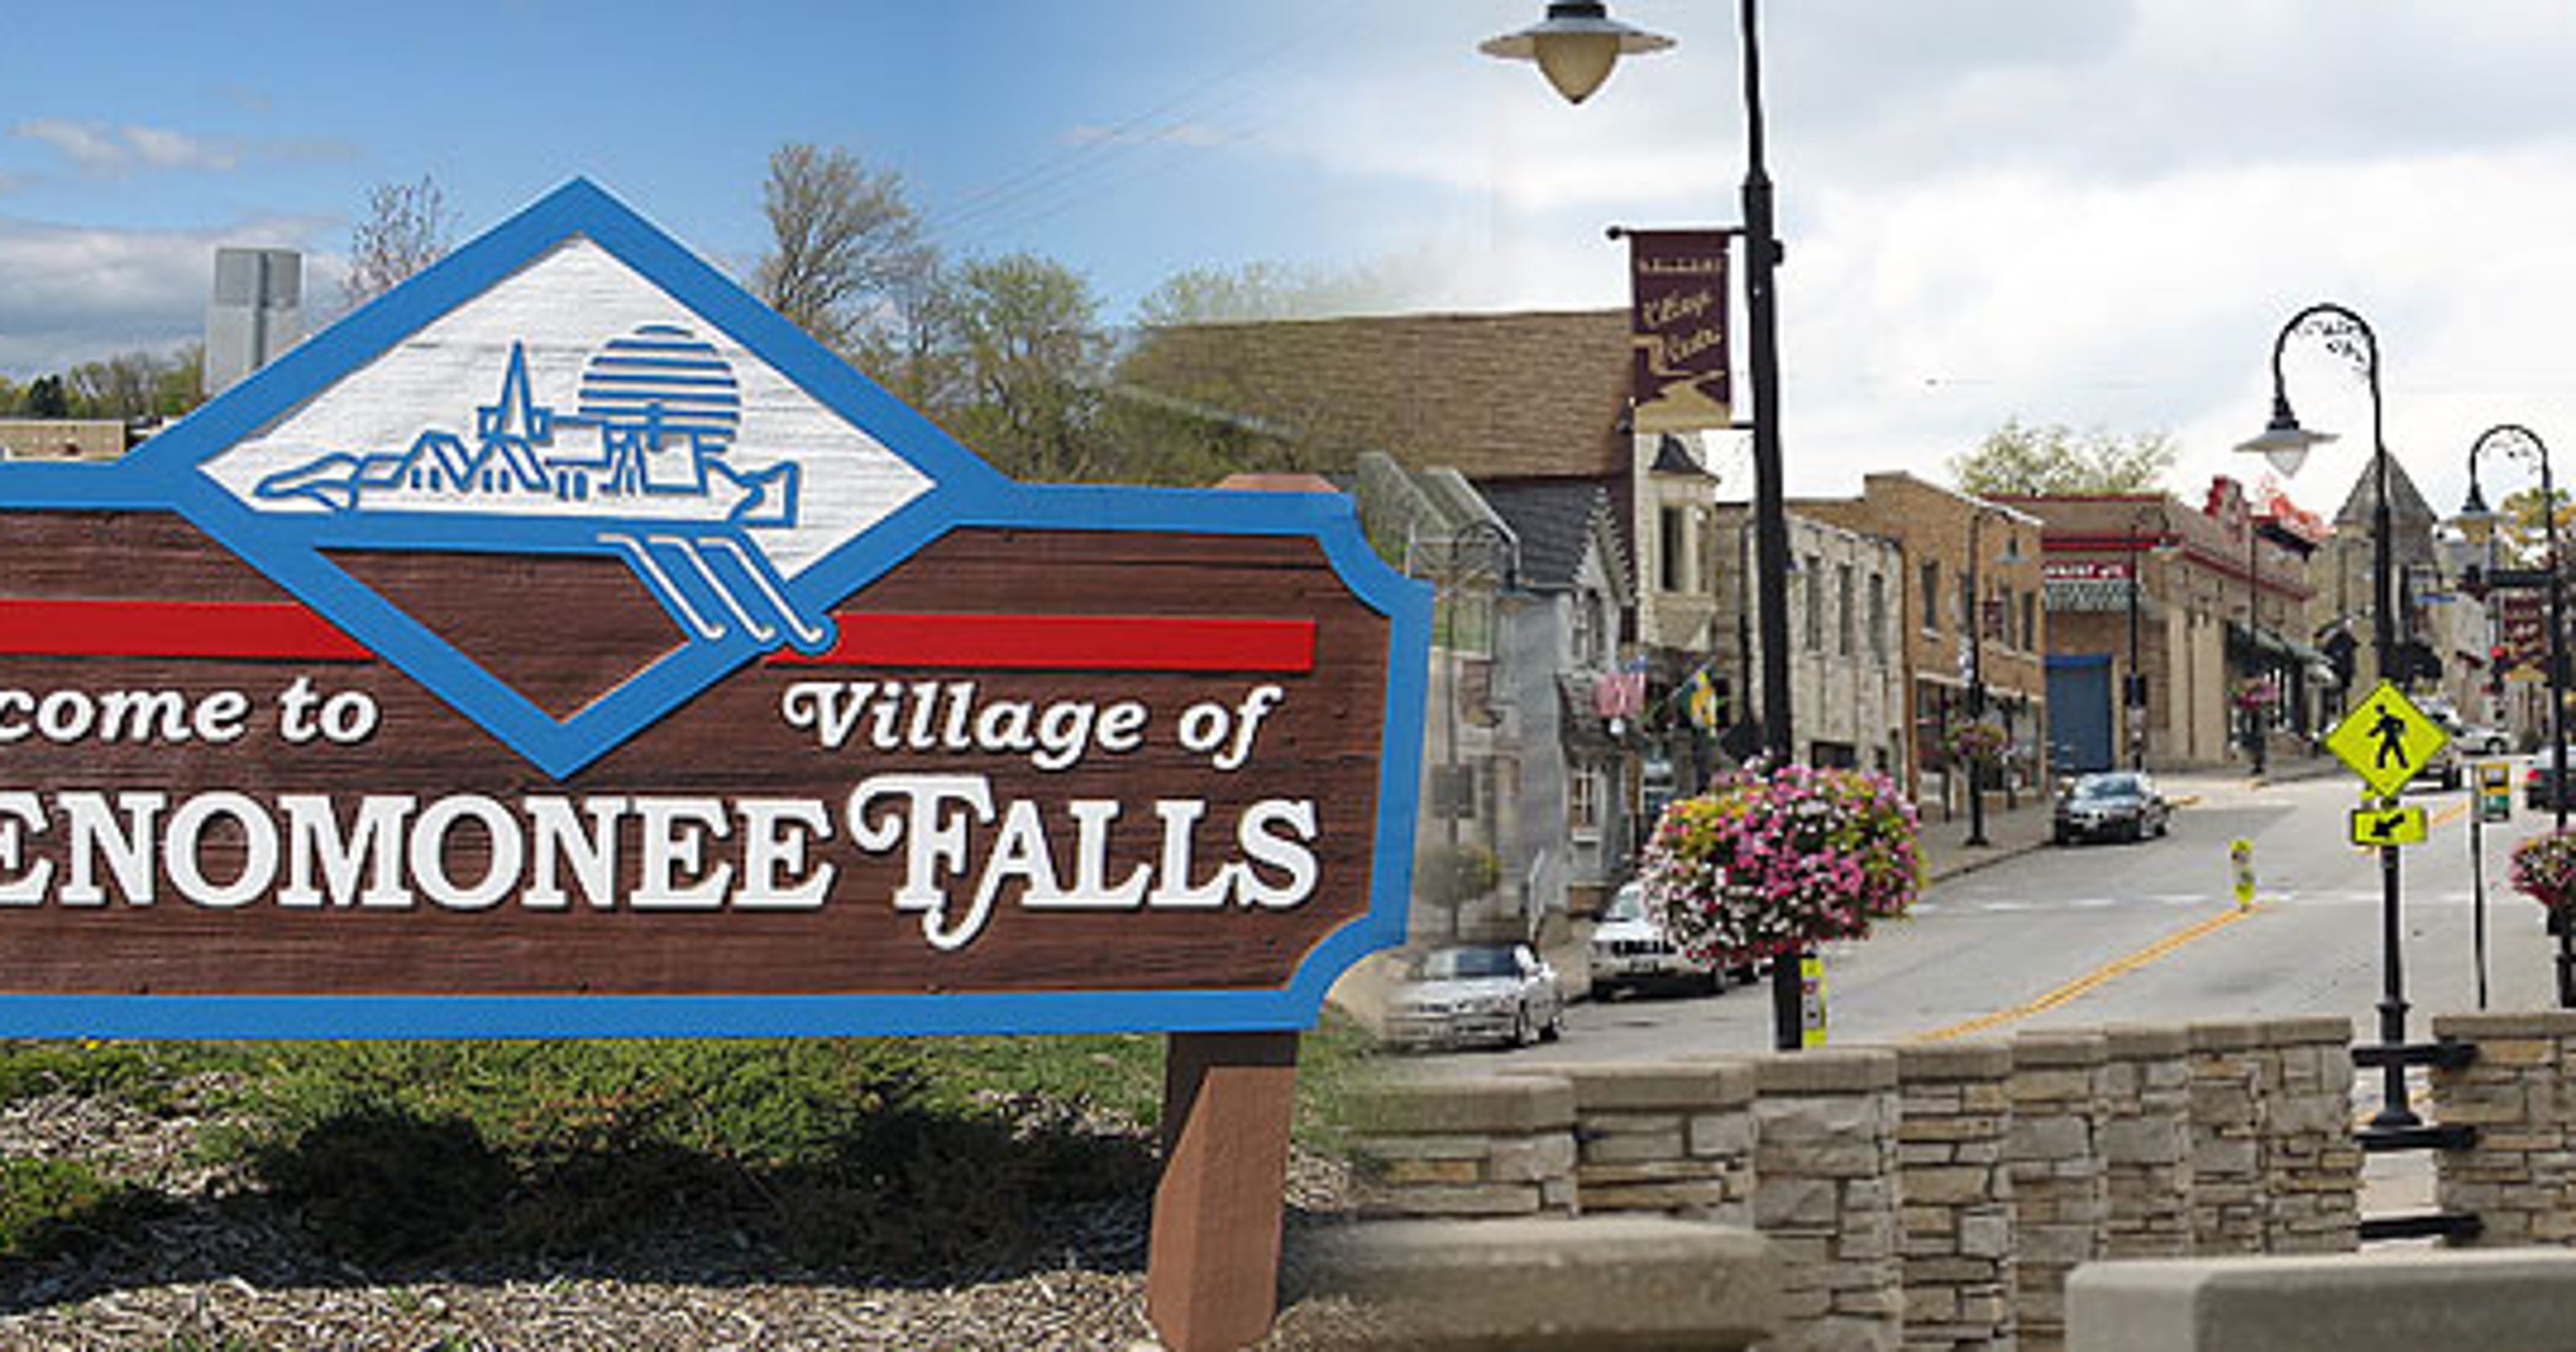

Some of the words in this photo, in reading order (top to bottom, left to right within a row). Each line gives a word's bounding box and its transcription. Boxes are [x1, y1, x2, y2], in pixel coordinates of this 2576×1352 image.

[0, 690, 248, 741] come
[279, 676, 378, 742] to
[782, 681, 1145, 769] Village
[1179, 685, 1283, 769] of
[846, 773, 1317, 950] FALLS
